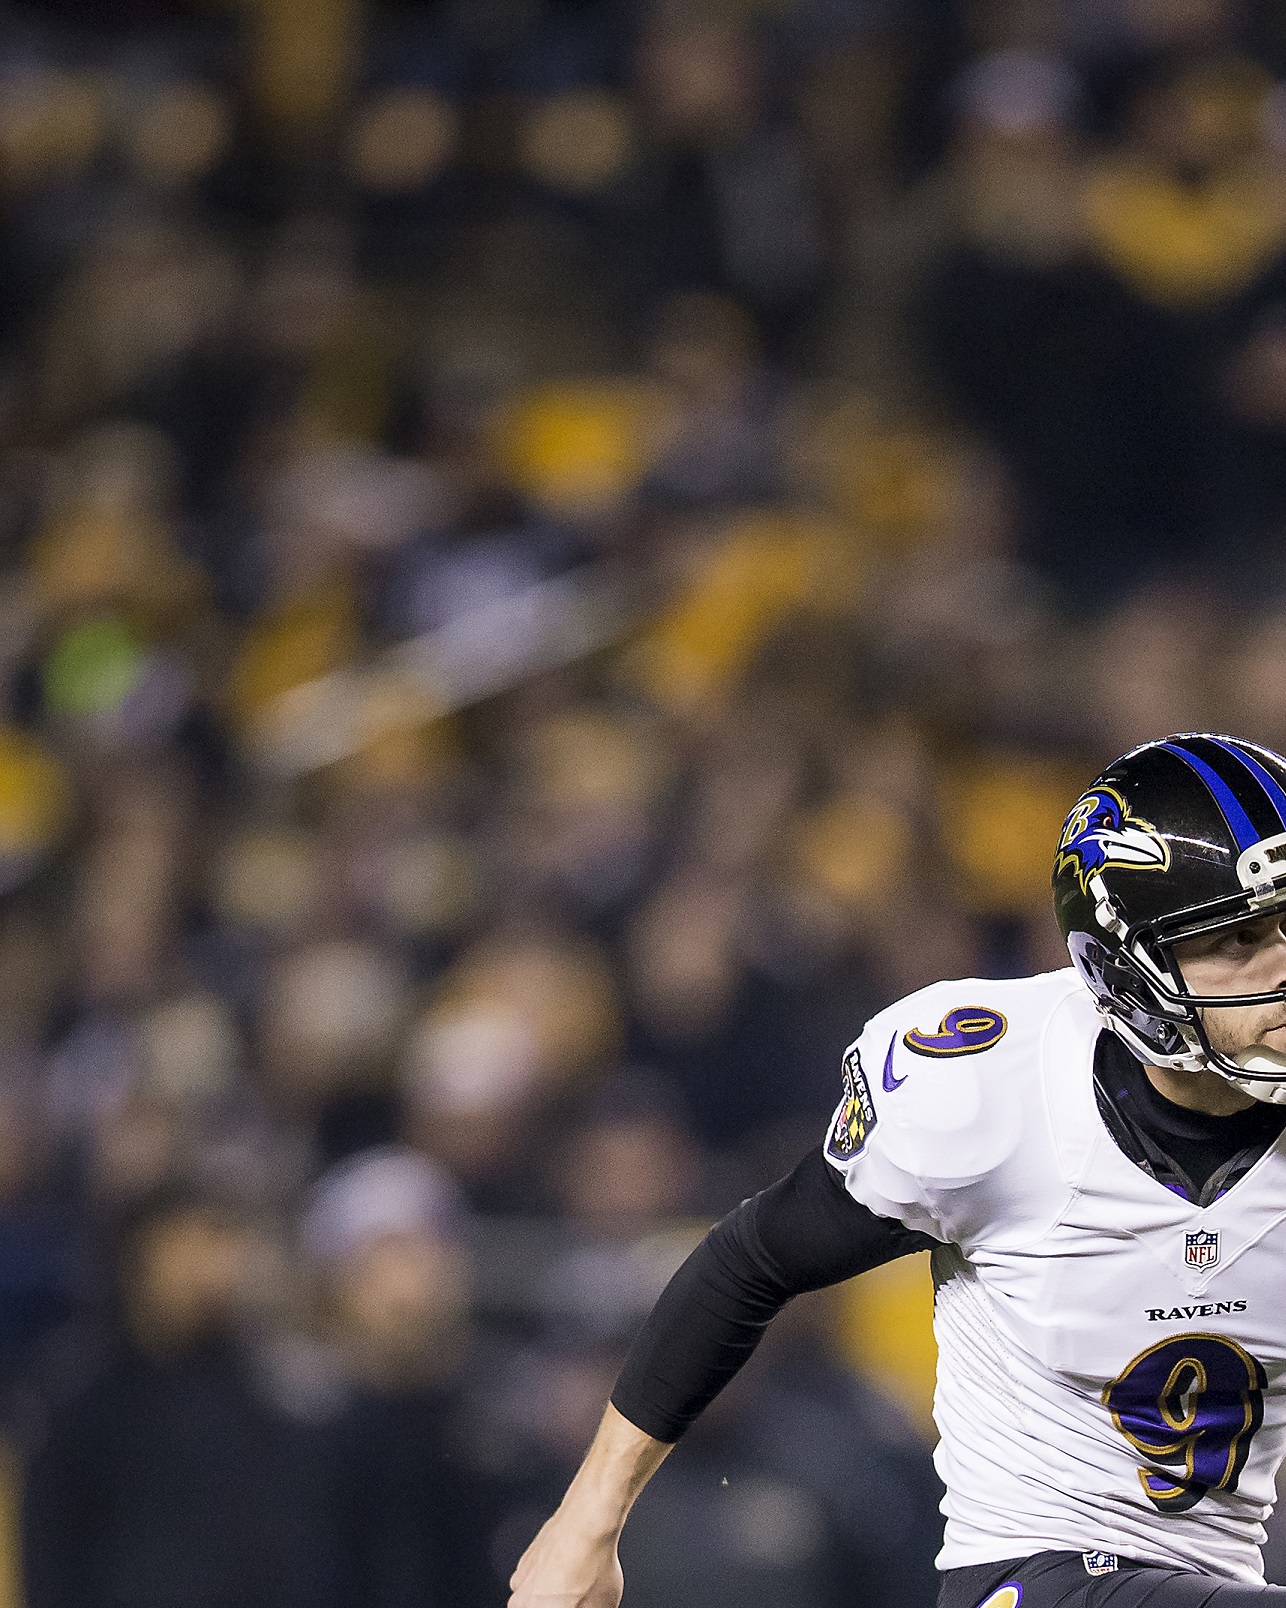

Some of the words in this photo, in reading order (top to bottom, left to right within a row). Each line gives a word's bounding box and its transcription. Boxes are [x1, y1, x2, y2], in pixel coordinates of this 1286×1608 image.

[903, 1005, 1008, 1058] 9
[1188, 1246, 1214, 1262] NFL
[1145, 1300, 1248, 1321] RAVENS
[1101, 1331, 1268, 1512] 9
